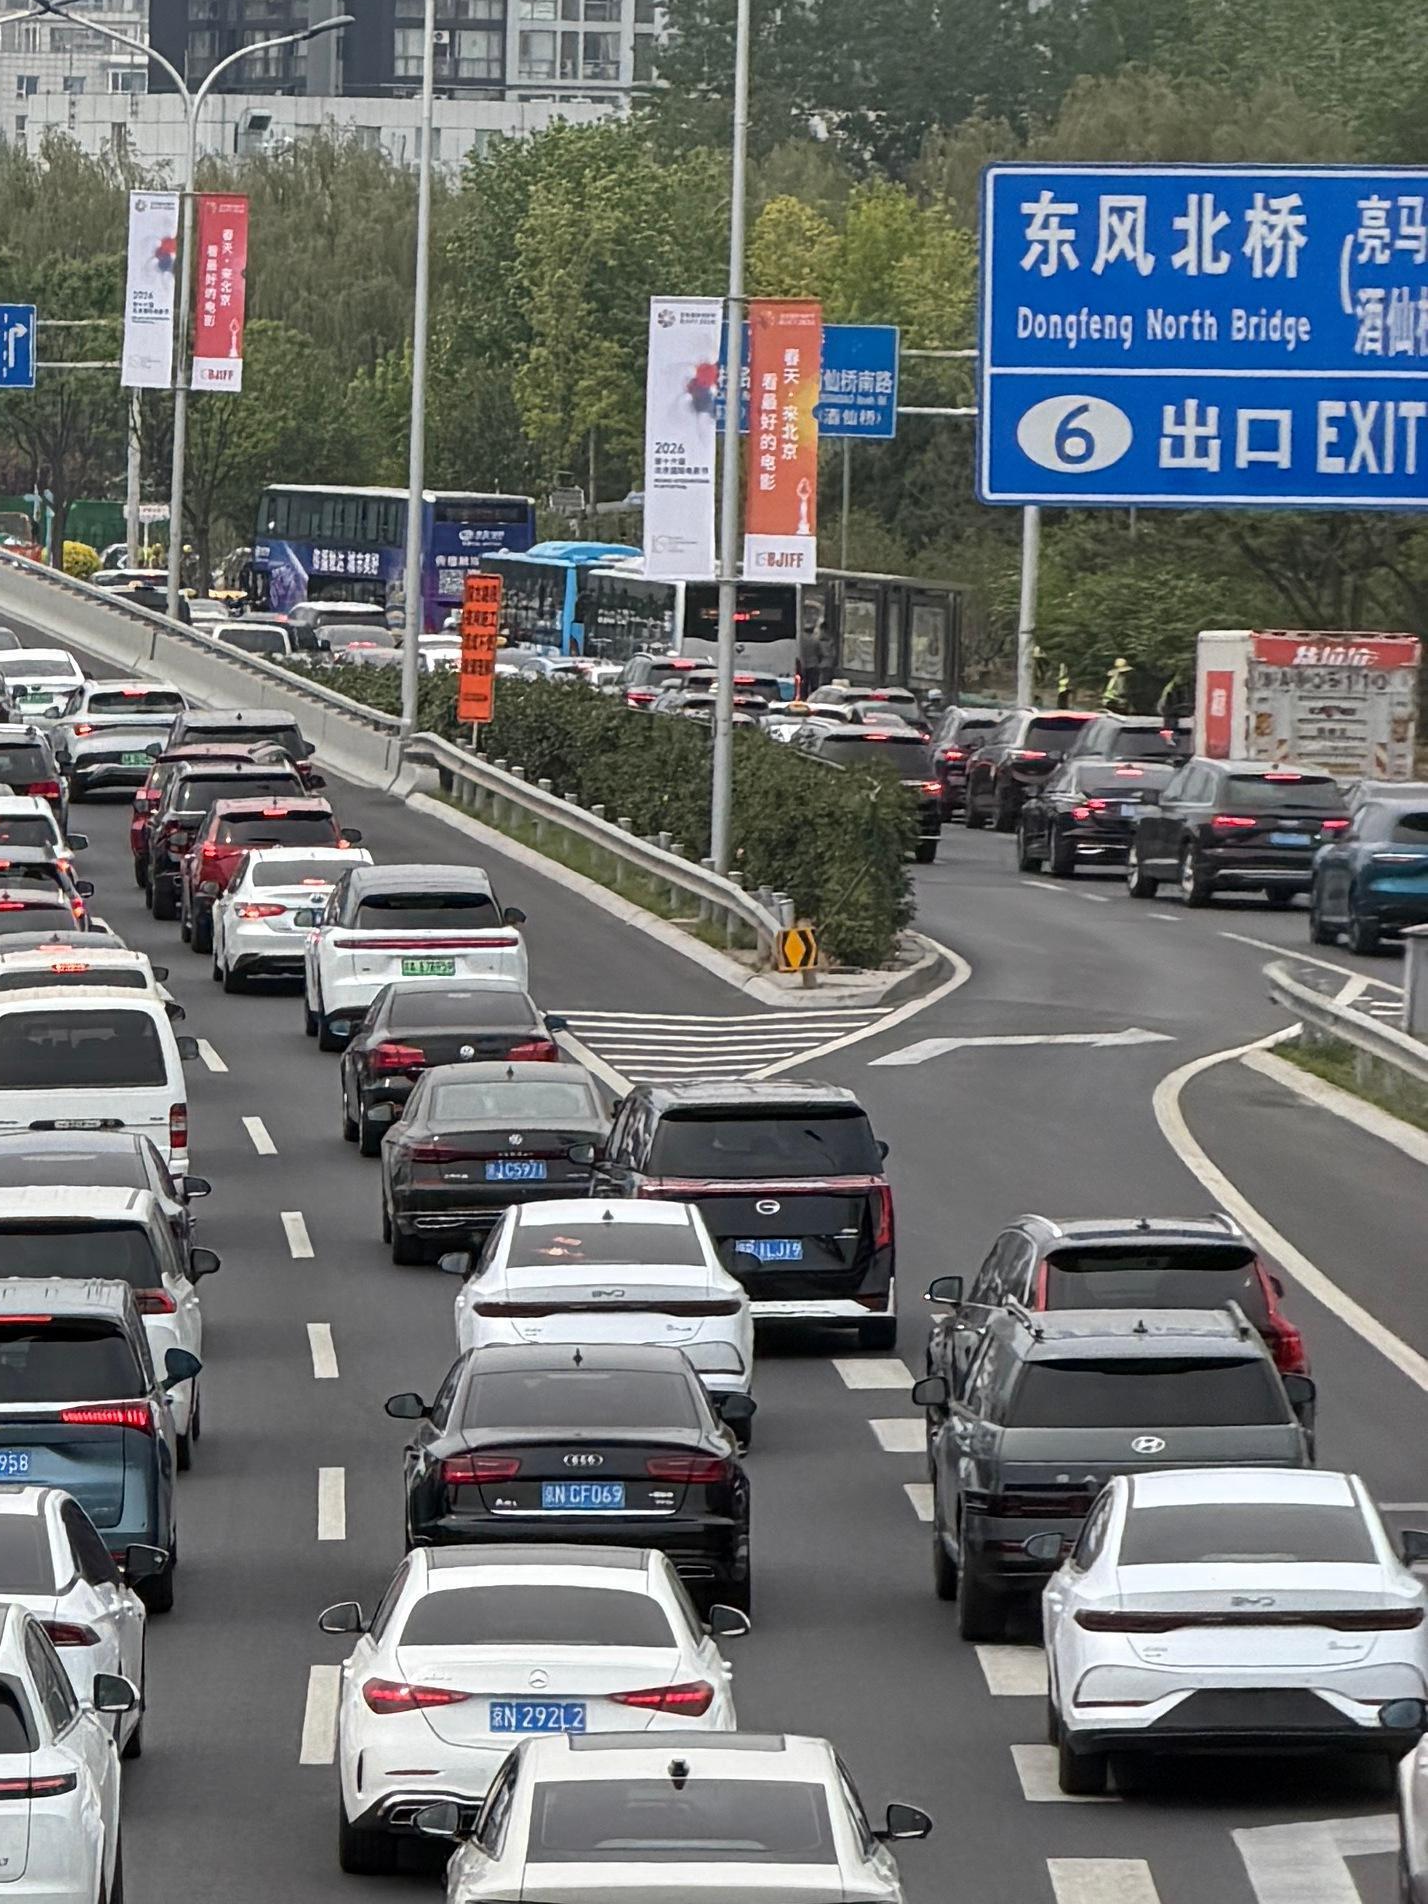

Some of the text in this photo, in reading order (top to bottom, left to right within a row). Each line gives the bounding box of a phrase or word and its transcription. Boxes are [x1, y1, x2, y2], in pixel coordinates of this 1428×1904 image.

[1019, 190, 1308, 279] 东风北桥
[1017, 306, 1311, 351] Dongfeng North Bridge
[1354, 286, 1428, 358] 酒仙
[821, 369, 892, 394] 仙桥南路
[654, 442, 685, 455] 2026
[759, 372, 779, 491] 看最好的电影
[1054, 403, 1096, 465] 6
[1158, 398, 1293, 473] 出口
[1316, 400, 1428, 475] EXIT
